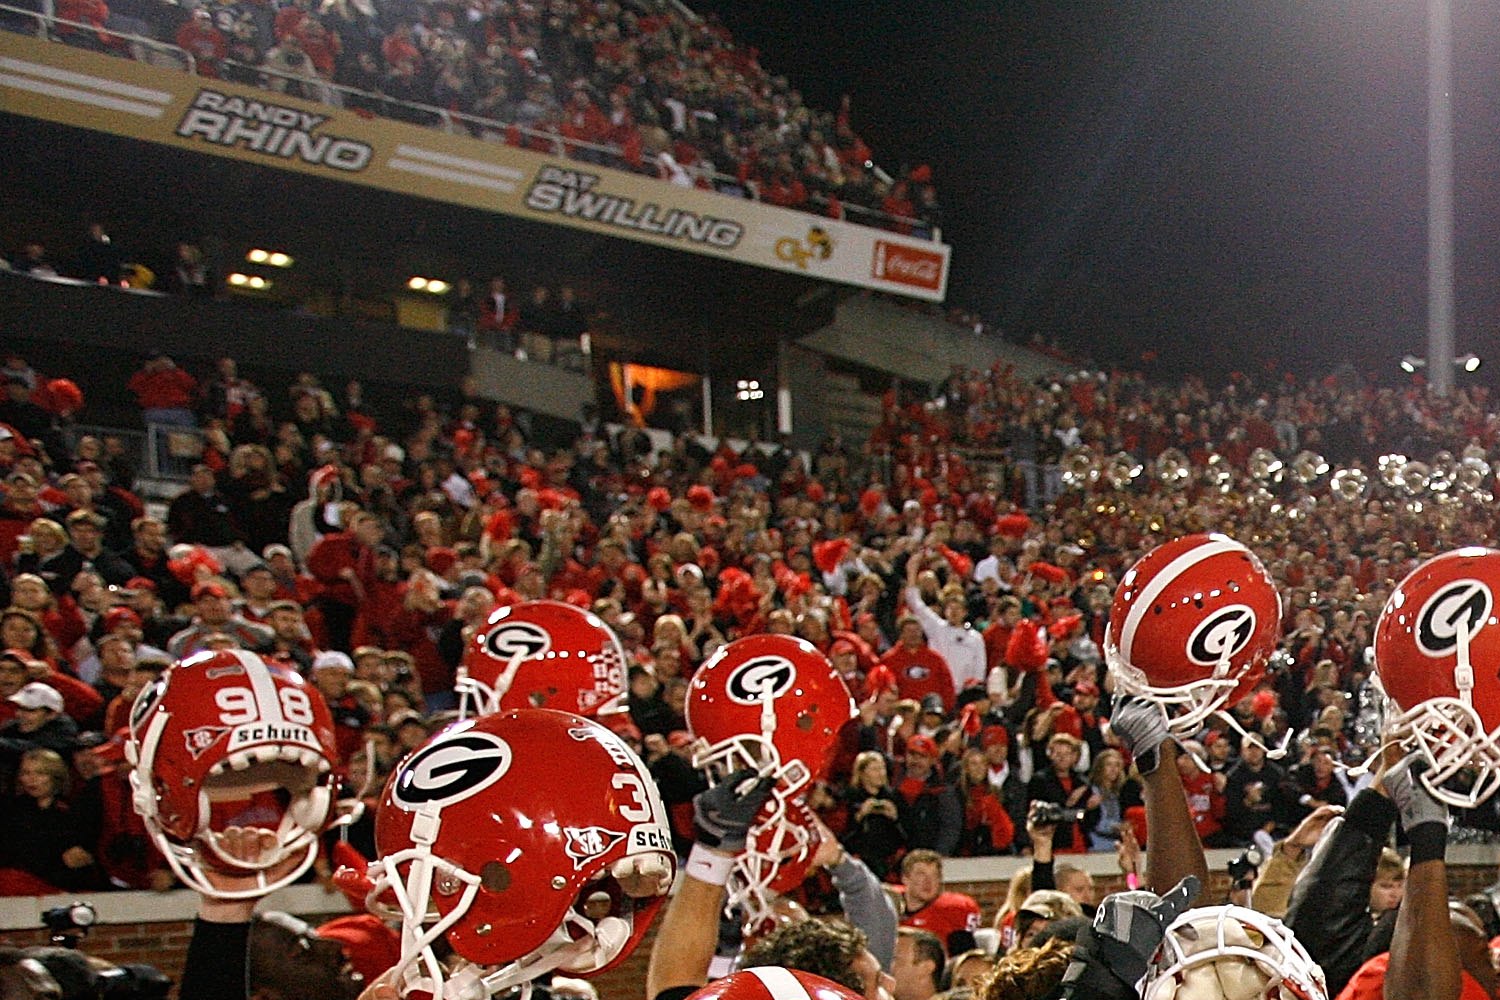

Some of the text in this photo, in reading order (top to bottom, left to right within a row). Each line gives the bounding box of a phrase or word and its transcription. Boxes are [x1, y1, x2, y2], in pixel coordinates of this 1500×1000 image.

[194, 88, 326, 131] RANDY
[177, 110, 373, 171] RHINO
[540, 166, 596, 190] PAT
[527, 182, 742, 247] SWILLING
[238, 725, 308, 742] schutt
[611, 773, 651, 822] 3
[636, 829, 671, 848] sch
